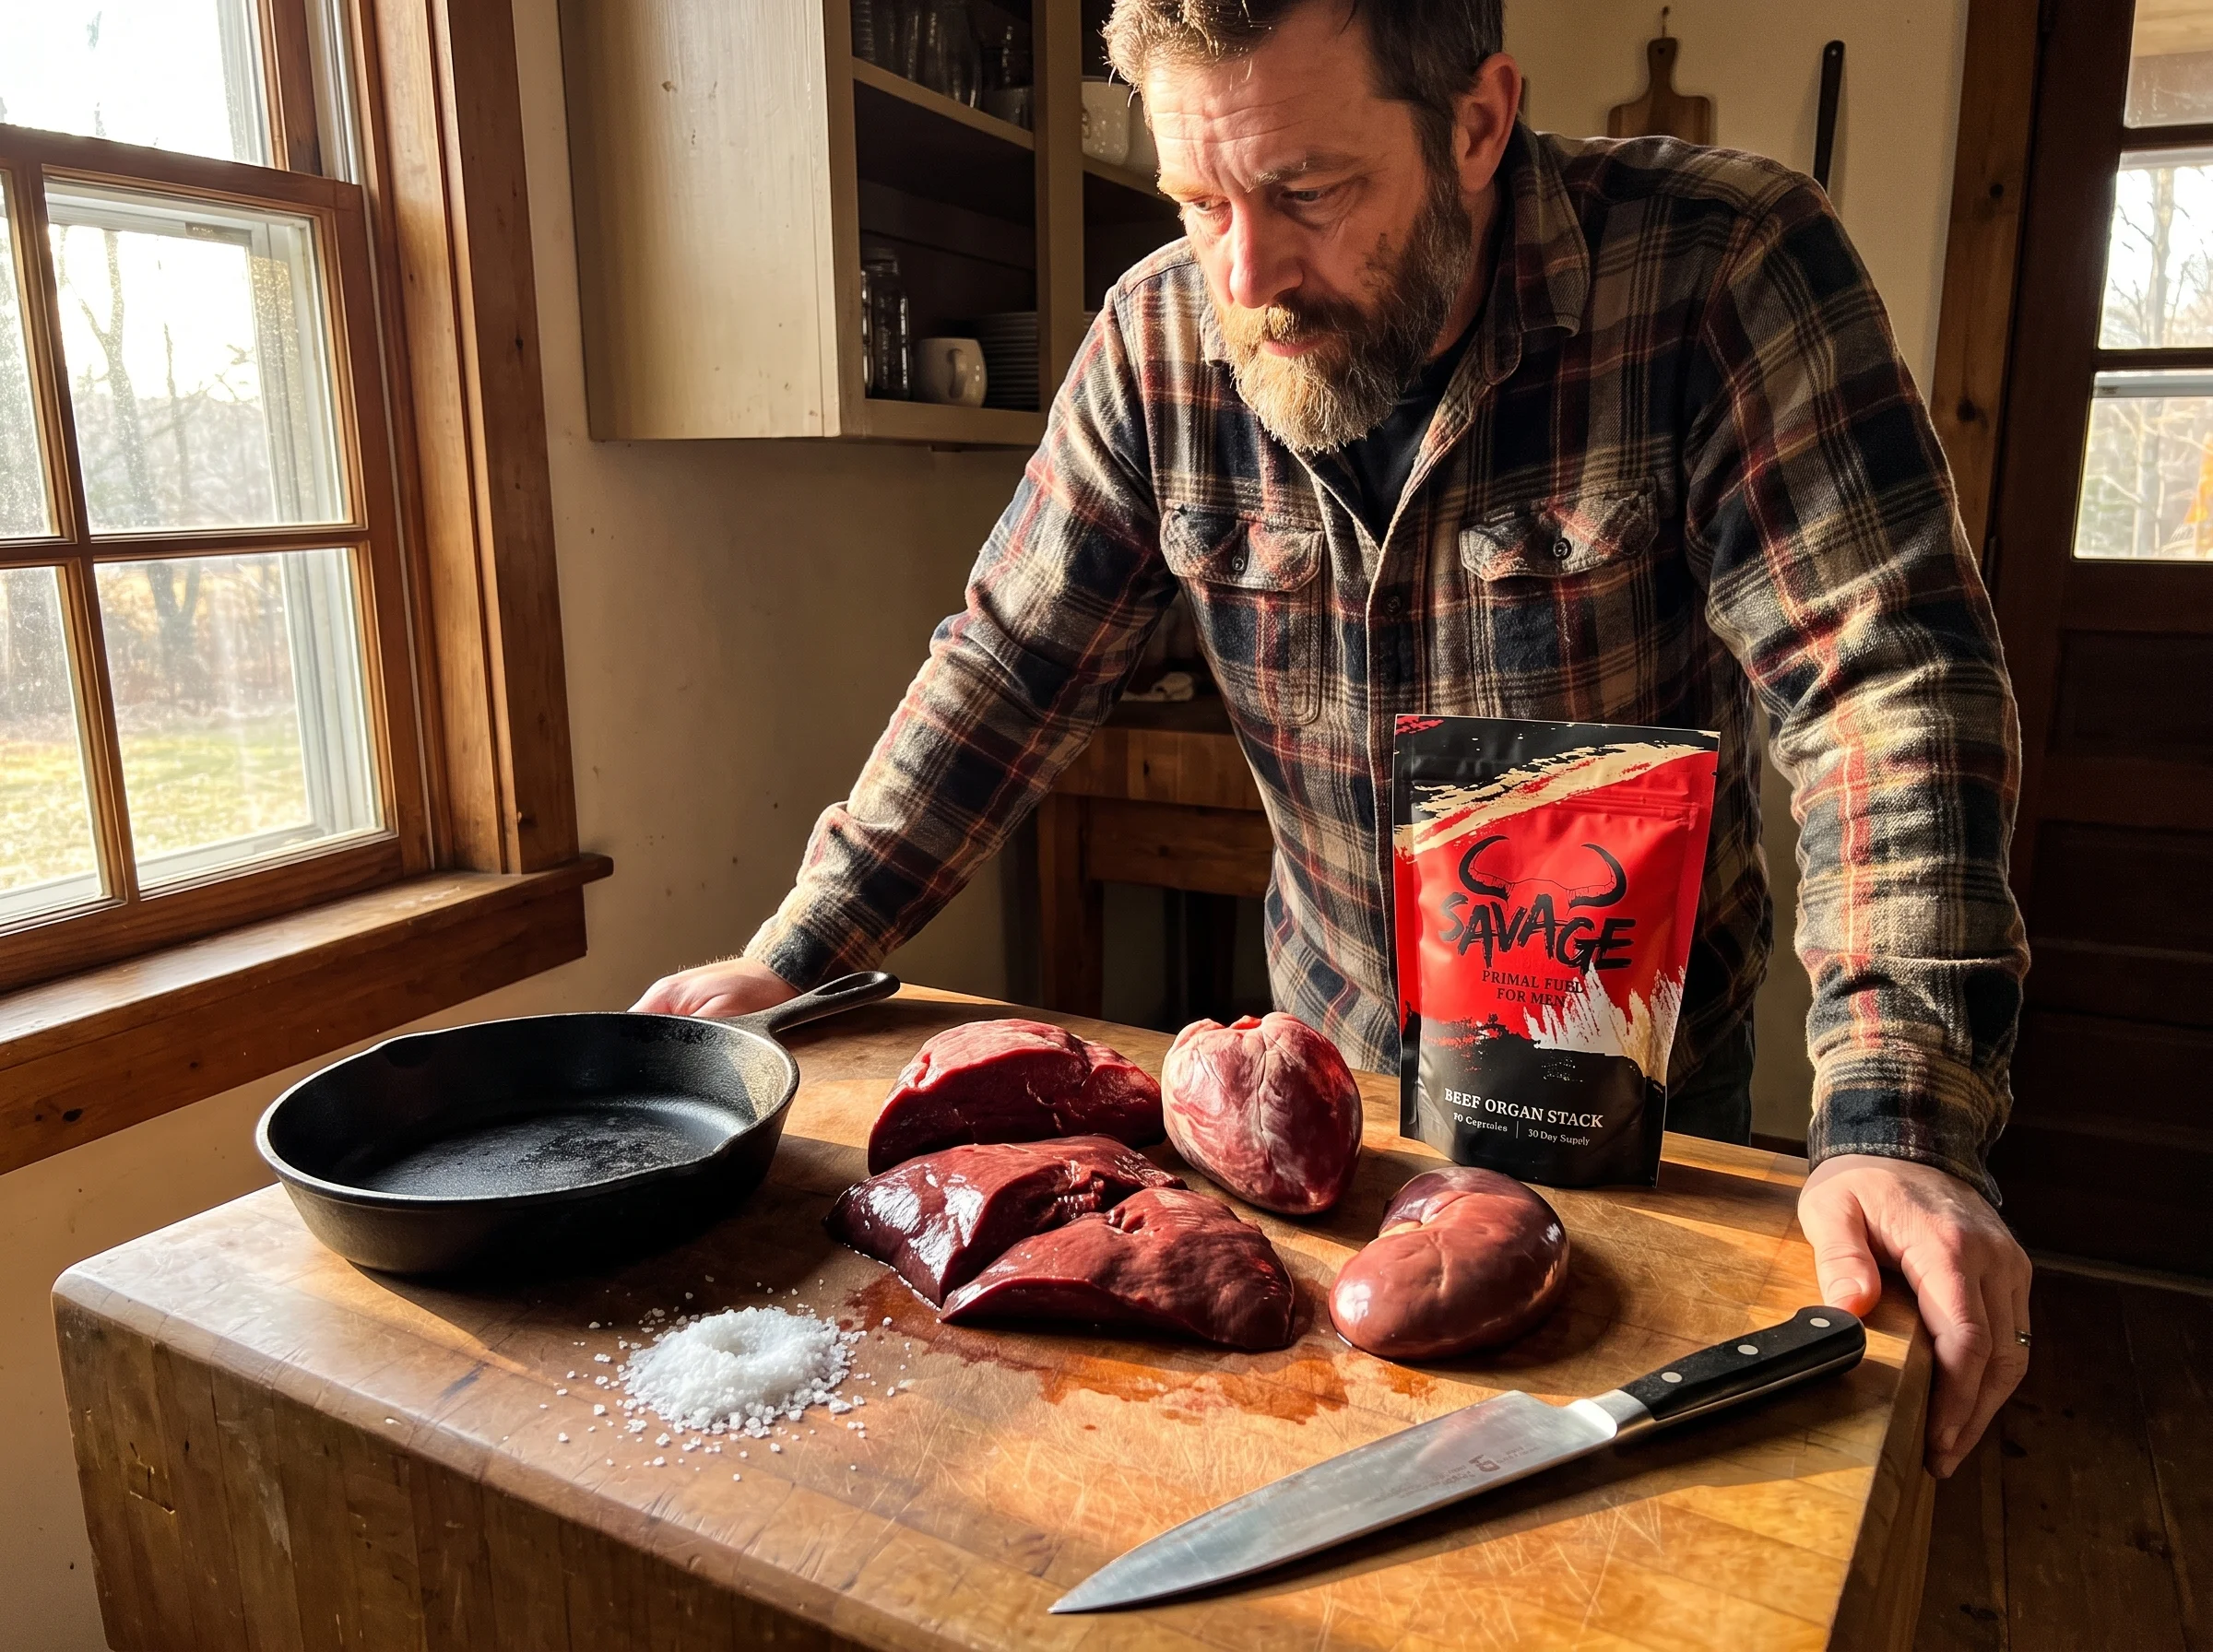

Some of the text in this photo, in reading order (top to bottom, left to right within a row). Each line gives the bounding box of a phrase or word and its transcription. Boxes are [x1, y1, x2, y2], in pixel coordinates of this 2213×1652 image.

[1439, 892, 1635, 975] SAVAGE
[1483, 970, 1539, 989] PRIMAL
[1497, 988, 1566, 1008] FOR MEN
[1445, 1088, 1604, 1128] BEEF ORGAN STACK
[1528, 1128, 1539, 1138] 30
[1540, 1130, 1557, 1142] Day
